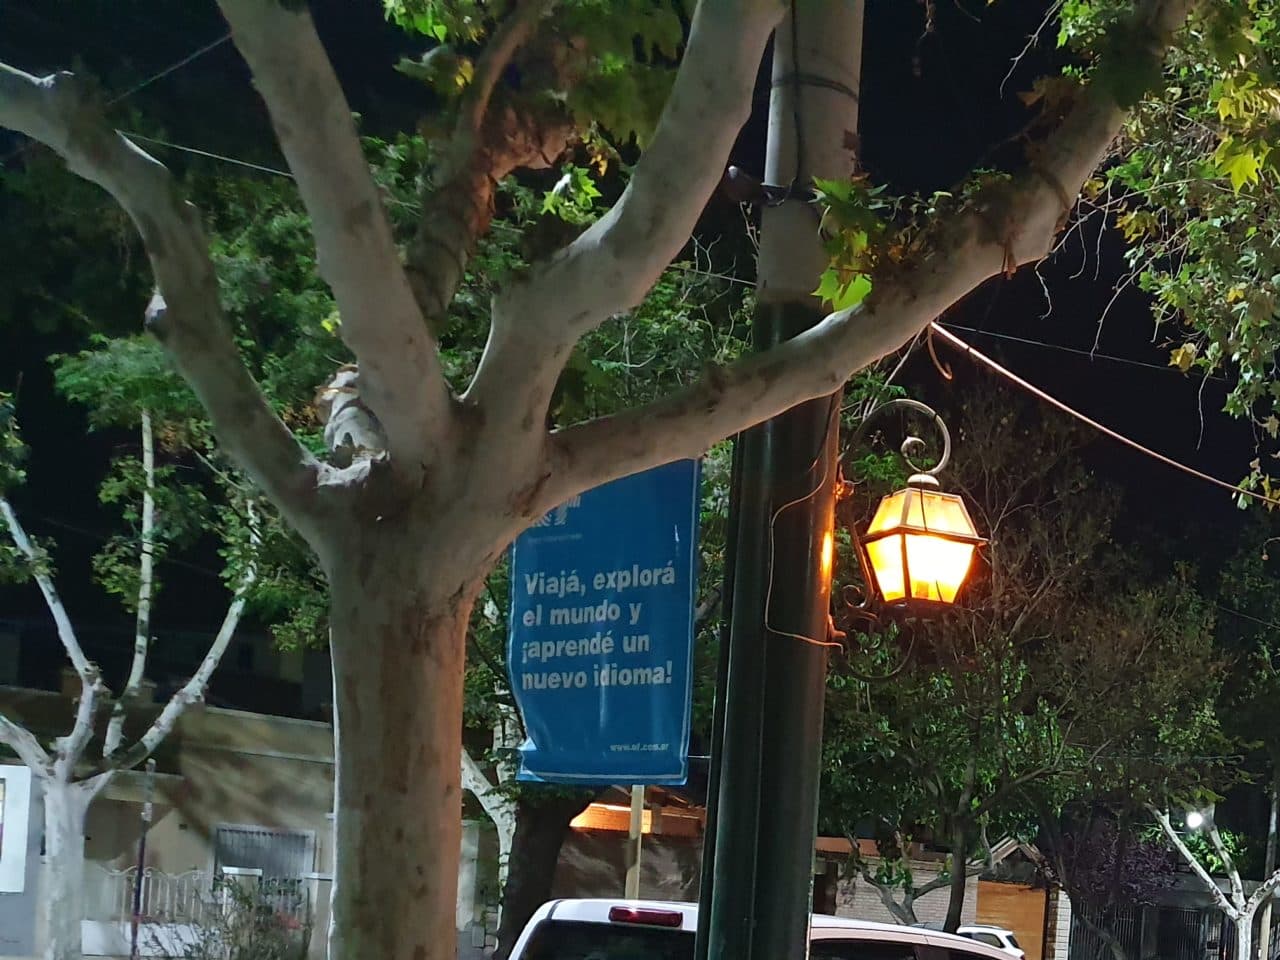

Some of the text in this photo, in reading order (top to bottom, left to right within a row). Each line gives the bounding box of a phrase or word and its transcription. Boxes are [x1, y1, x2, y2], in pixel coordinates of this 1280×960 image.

[525, 560, 675, 598] Viajá, explorá
[523, 599, 642, 626] el mundo y
[522, 631, 650, 663] ¡aprendé un
[522, 660, 673, 690] nuevo idioma!
